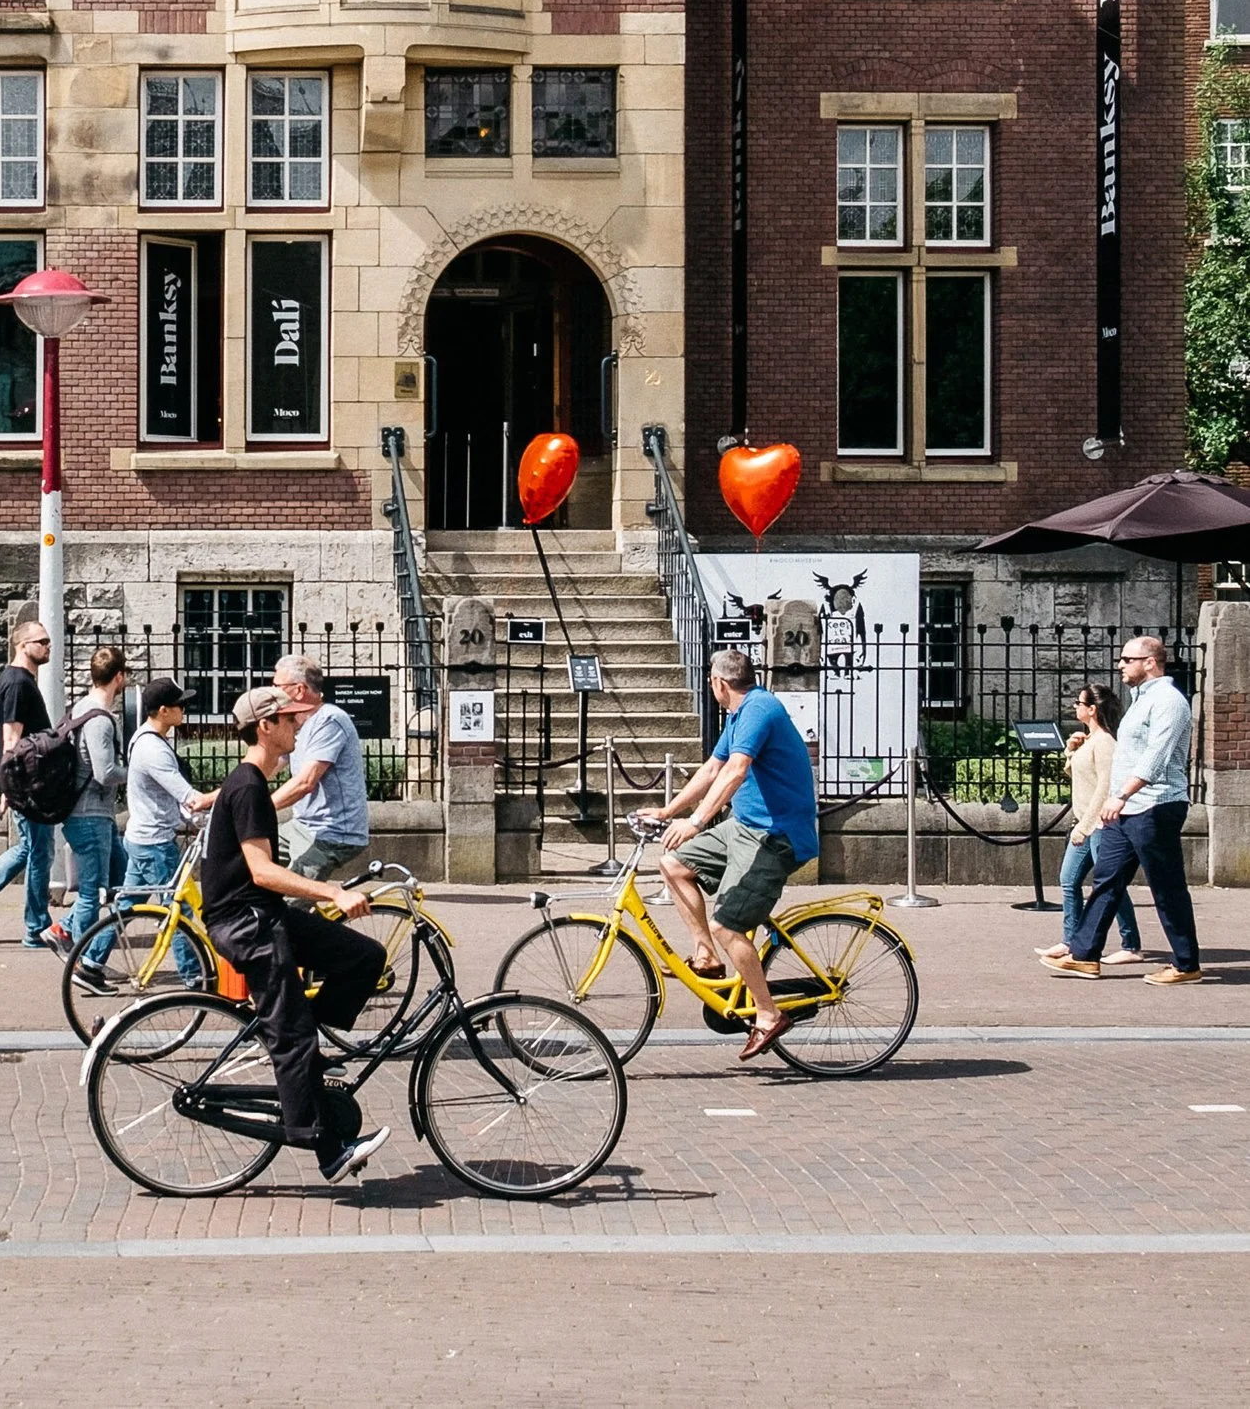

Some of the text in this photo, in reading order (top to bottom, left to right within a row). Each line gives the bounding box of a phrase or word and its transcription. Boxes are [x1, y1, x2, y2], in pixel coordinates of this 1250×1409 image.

[1100, 51, 1120, 237] Banksy
[158, 267, 182, 386] Banksy
[271, 299, 300, 367] Dalí
[159, 410, 178, 419] Moco
[273, 407, 300, 417] Moco
[459, 629, 485, 645] 20
[783, 630, 810, 648] 20
[640, 910, 665, 941] YELLOW
